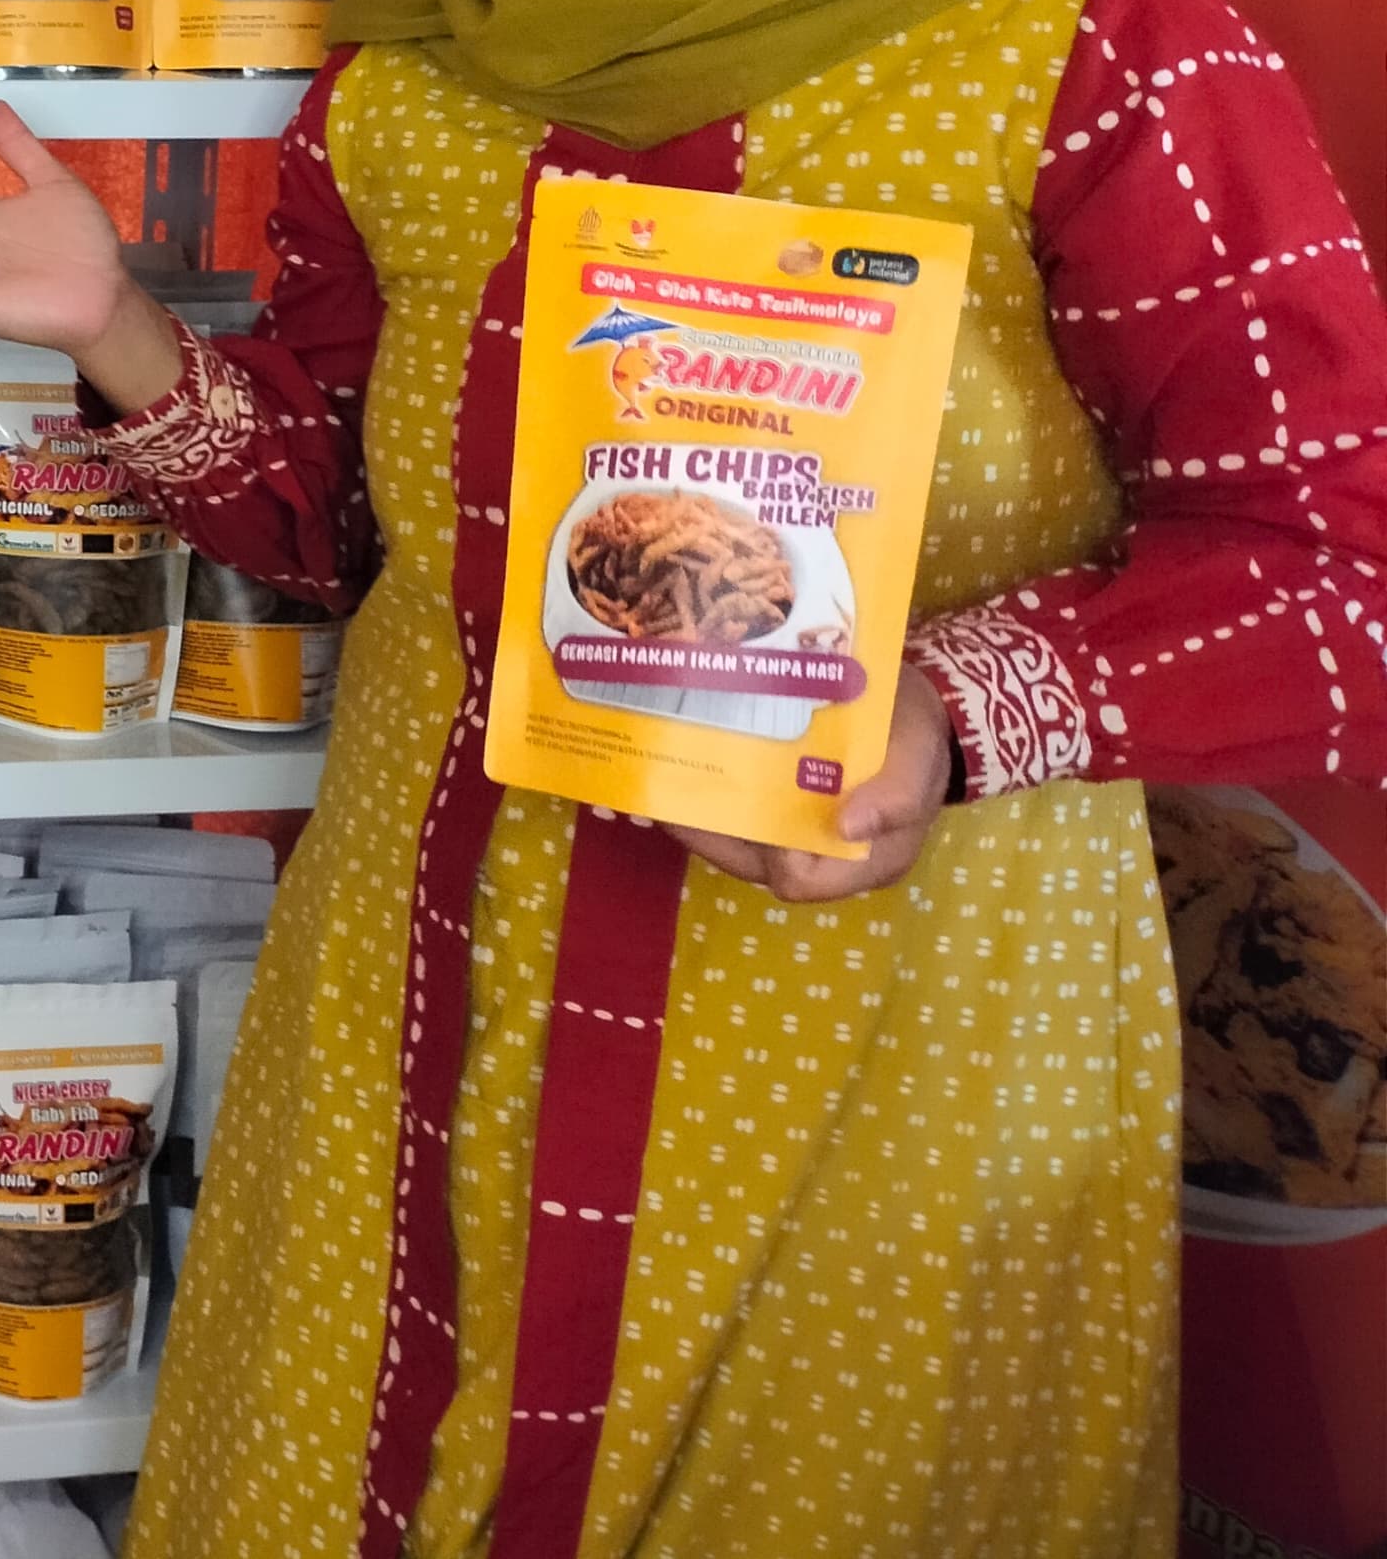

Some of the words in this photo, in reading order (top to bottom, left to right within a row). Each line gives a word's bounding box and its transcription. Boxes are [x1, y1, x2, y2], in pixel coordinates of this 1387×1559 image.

[592, 269, 637, 296] Oleh
[658, 279, 703, 304] Oleh
[705, 286, 754, 311] Kota
[758, 291, 882, 328] Tasikmalaya
[657, 343, 863, 416] RANDINI
[654, 397, 794, 436] ORIGINAL
[586, 446, 673, 482] FISH
[684, 450, 820, 487] CHIPS
[742, 479, 809, 503] BABY
[815, 484, 876, 509] FISH
[758, 504, 836, 529] NILEM
[560, 641, 619, 666] SENSASI
[622, 645, 685, 670] MAKAN
[690, 650, 738, 671] IKAN
[743, 655, 803, 679] TANPA
[806, 661, 845, 681] NASI
